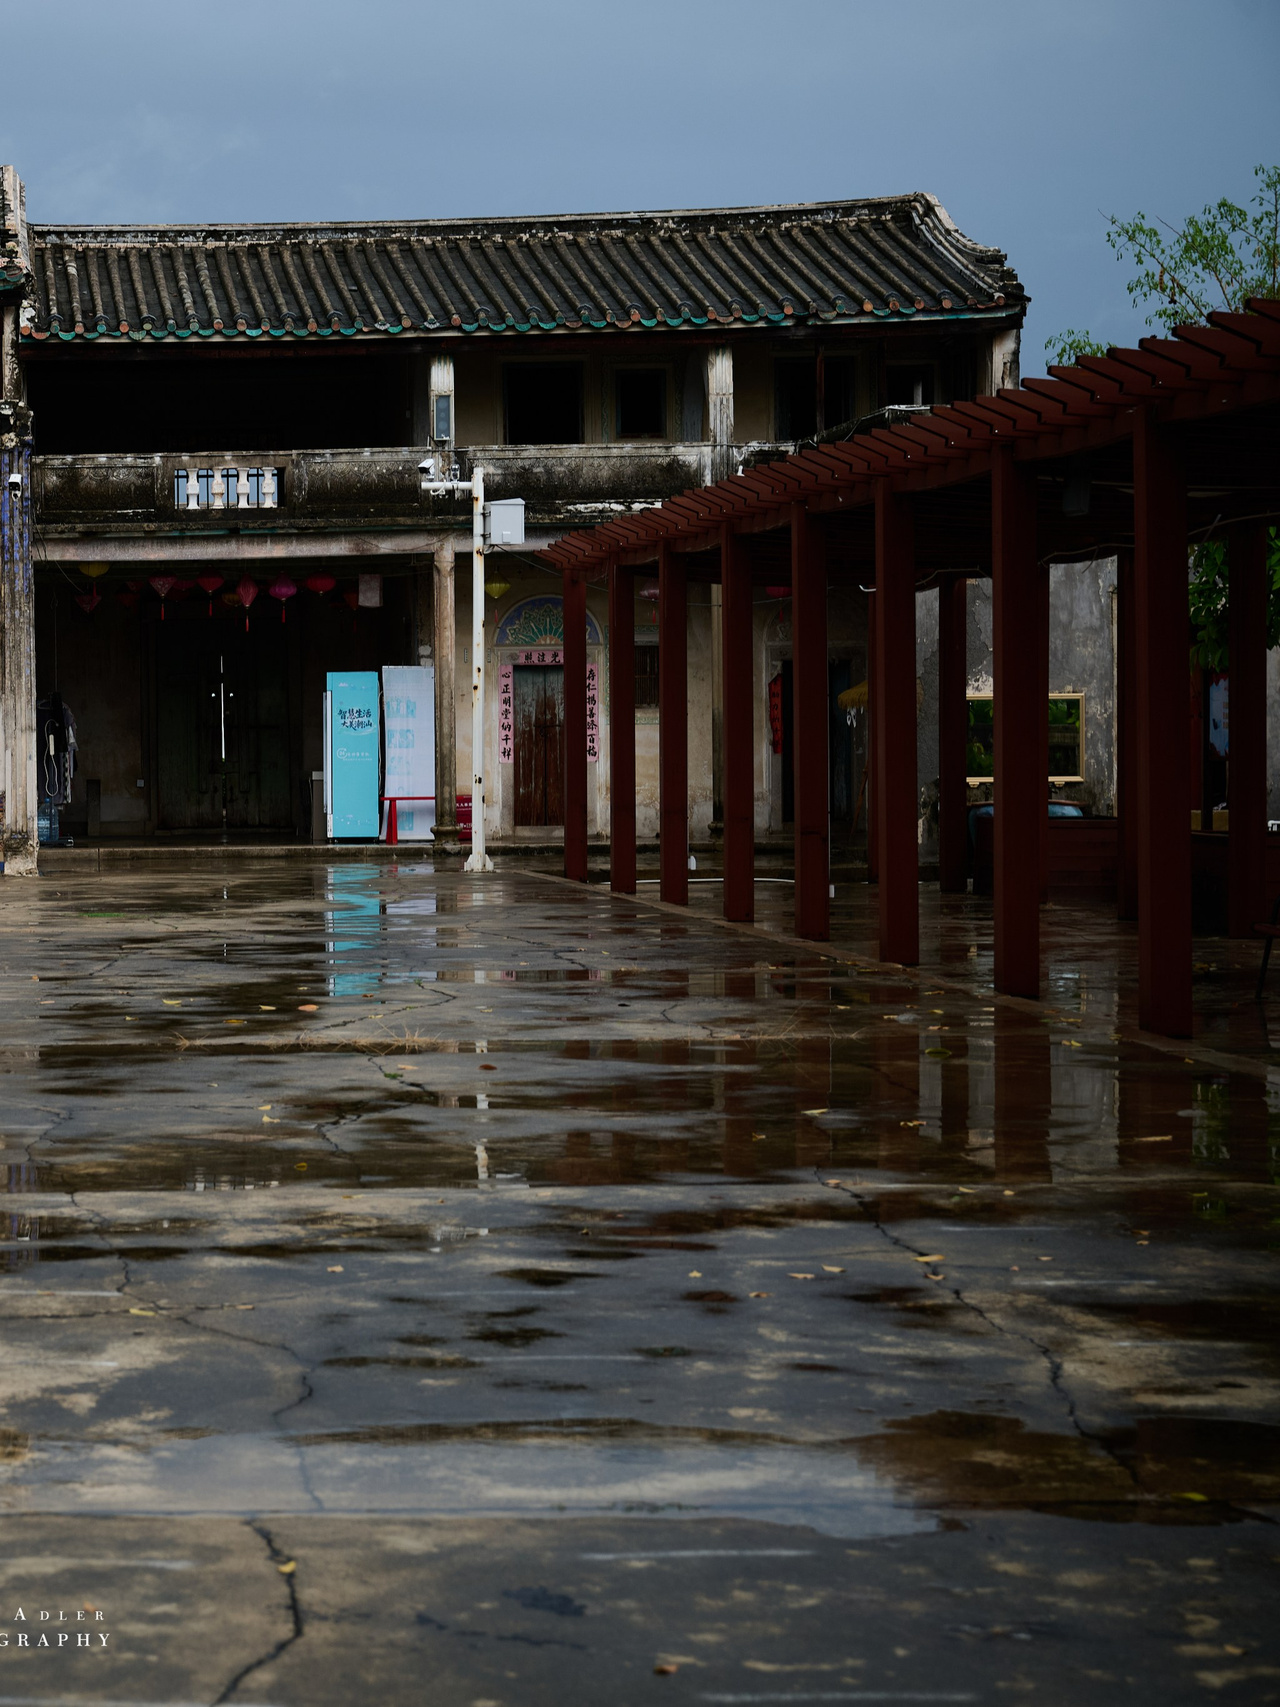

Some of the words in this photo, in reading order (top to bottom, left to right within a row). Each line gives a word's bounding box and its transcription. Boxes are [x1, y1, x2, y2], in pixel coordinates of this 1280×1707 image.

[337, 708, 372, 720] 智慧生活
[341, 719, 373, 731] 大美潮汕
